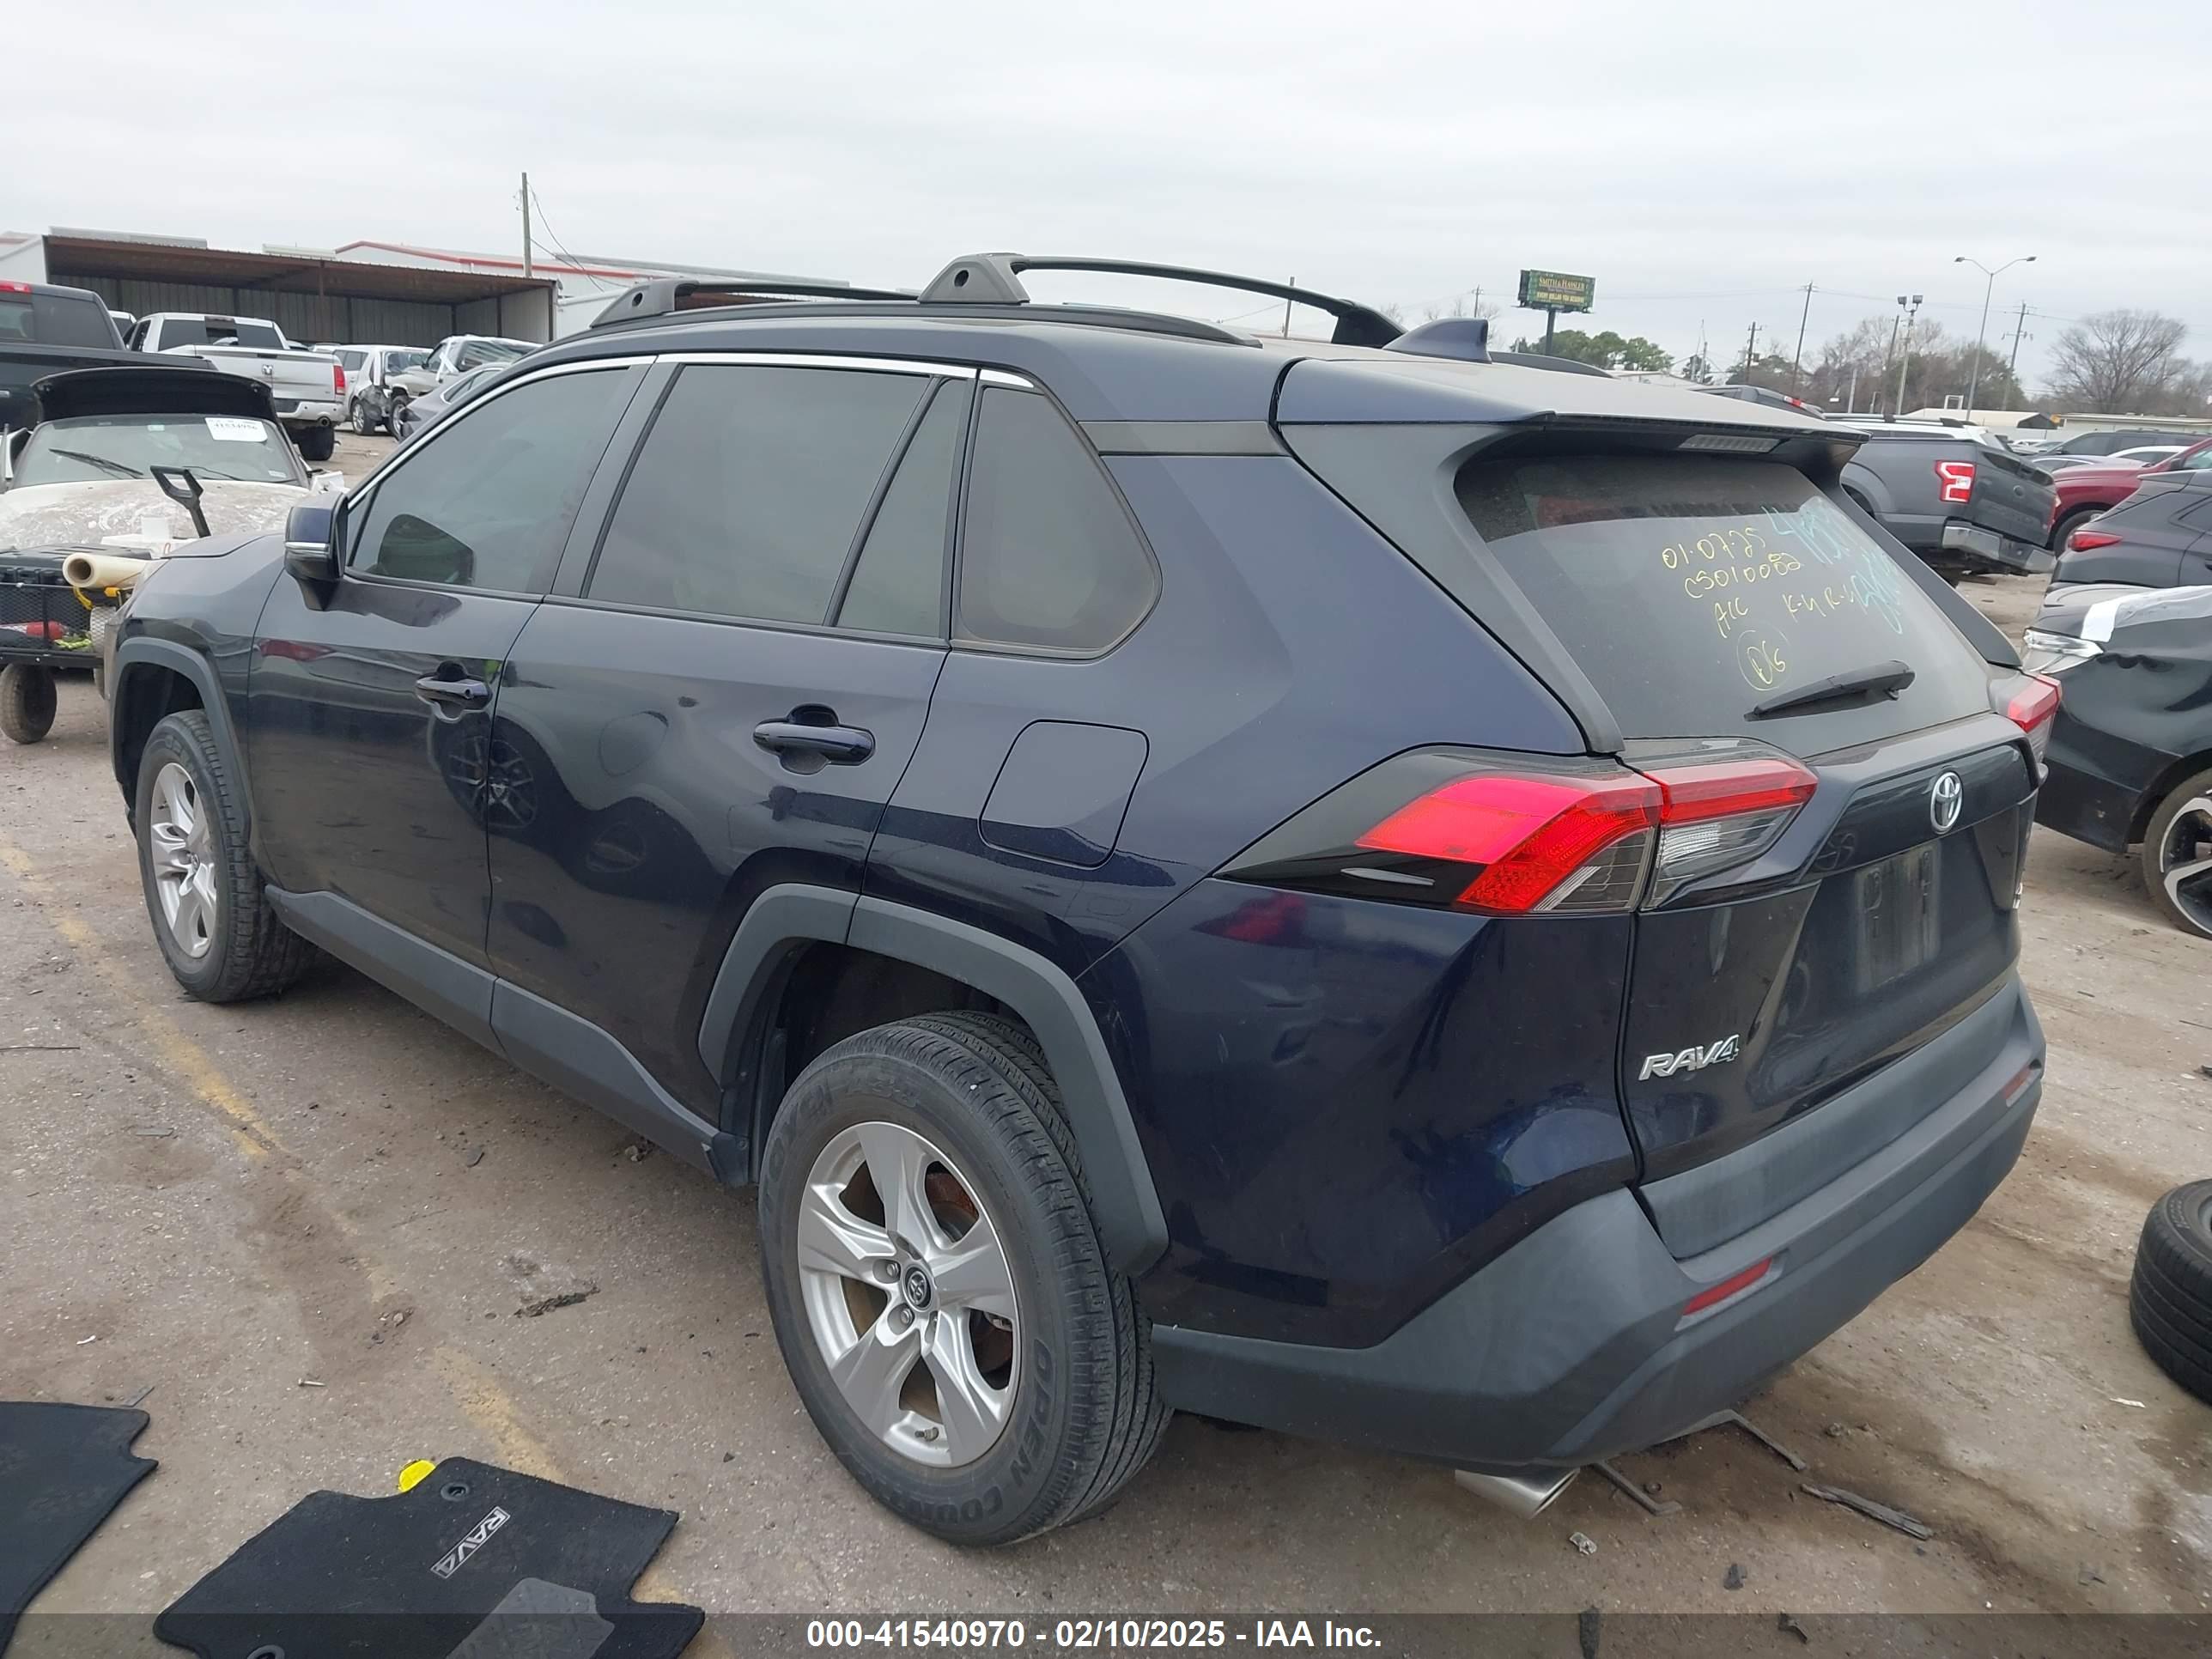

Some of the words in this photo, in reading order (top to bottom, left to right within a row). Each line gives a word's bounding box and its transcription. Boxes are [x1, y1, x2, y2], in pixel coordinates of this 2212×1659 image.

[1638, 1034, 1740, 1080] RAV4
[1010, 1338, 1055, 1486] OPEN
[435, 1510, 507, 1574] RAV4
